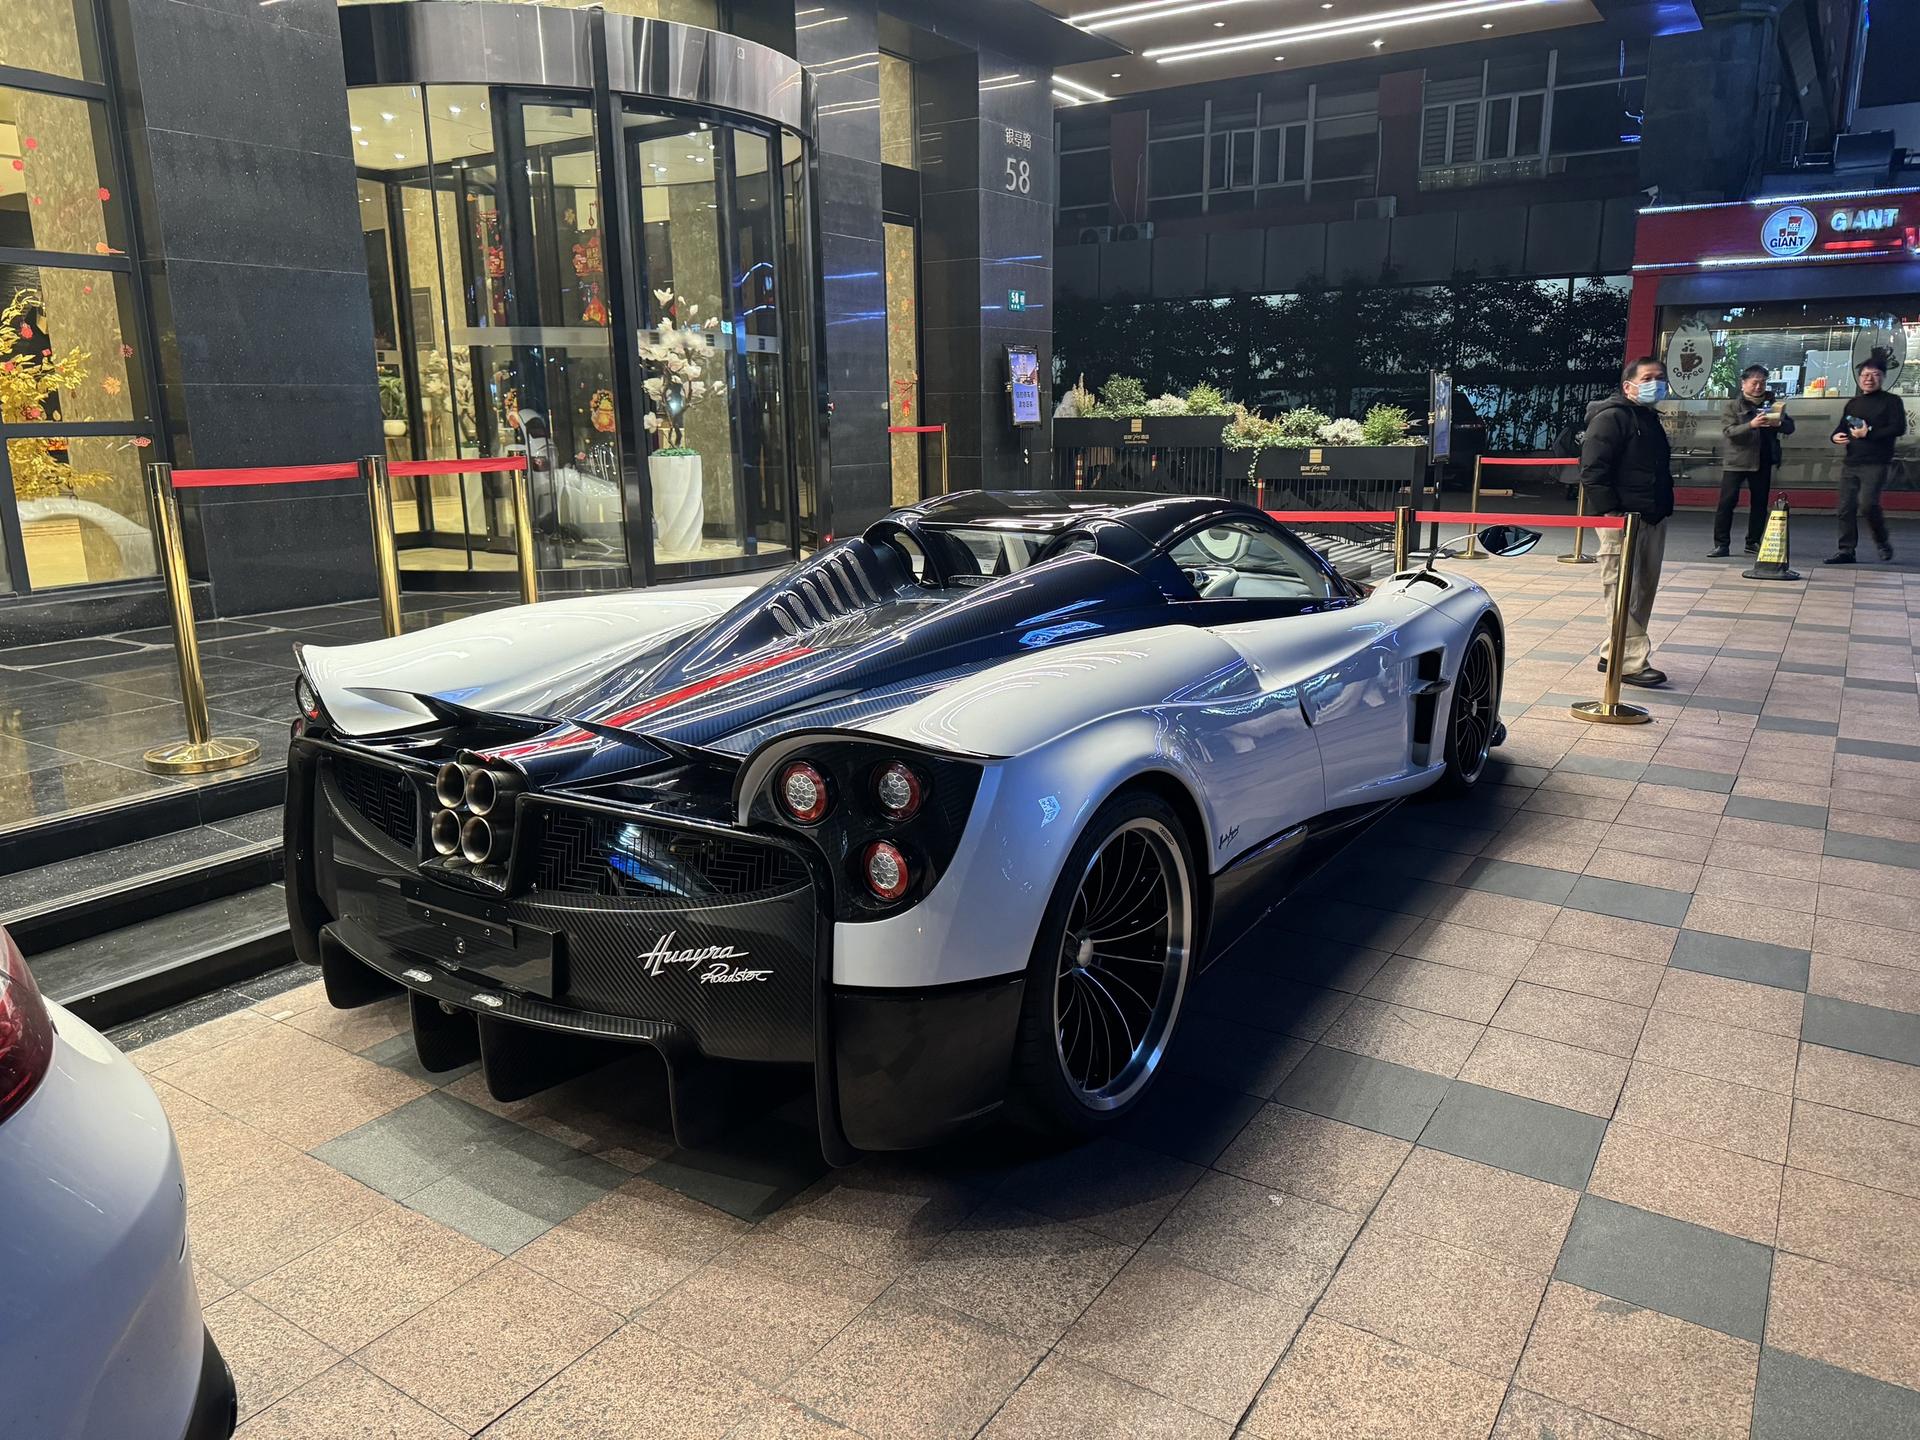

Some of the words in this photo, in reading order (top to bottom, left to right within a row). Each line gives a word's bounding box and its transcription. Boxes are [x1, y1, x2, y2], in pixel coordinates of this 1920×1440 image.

[1005, 157, 1031, 194] 58
[1011, 292, 1019, 304] 58
[1673, 367, 1705, 381] coffee
[637, 930, 750, 977] Huayra
[700, 963, 775, 985] Roadster
